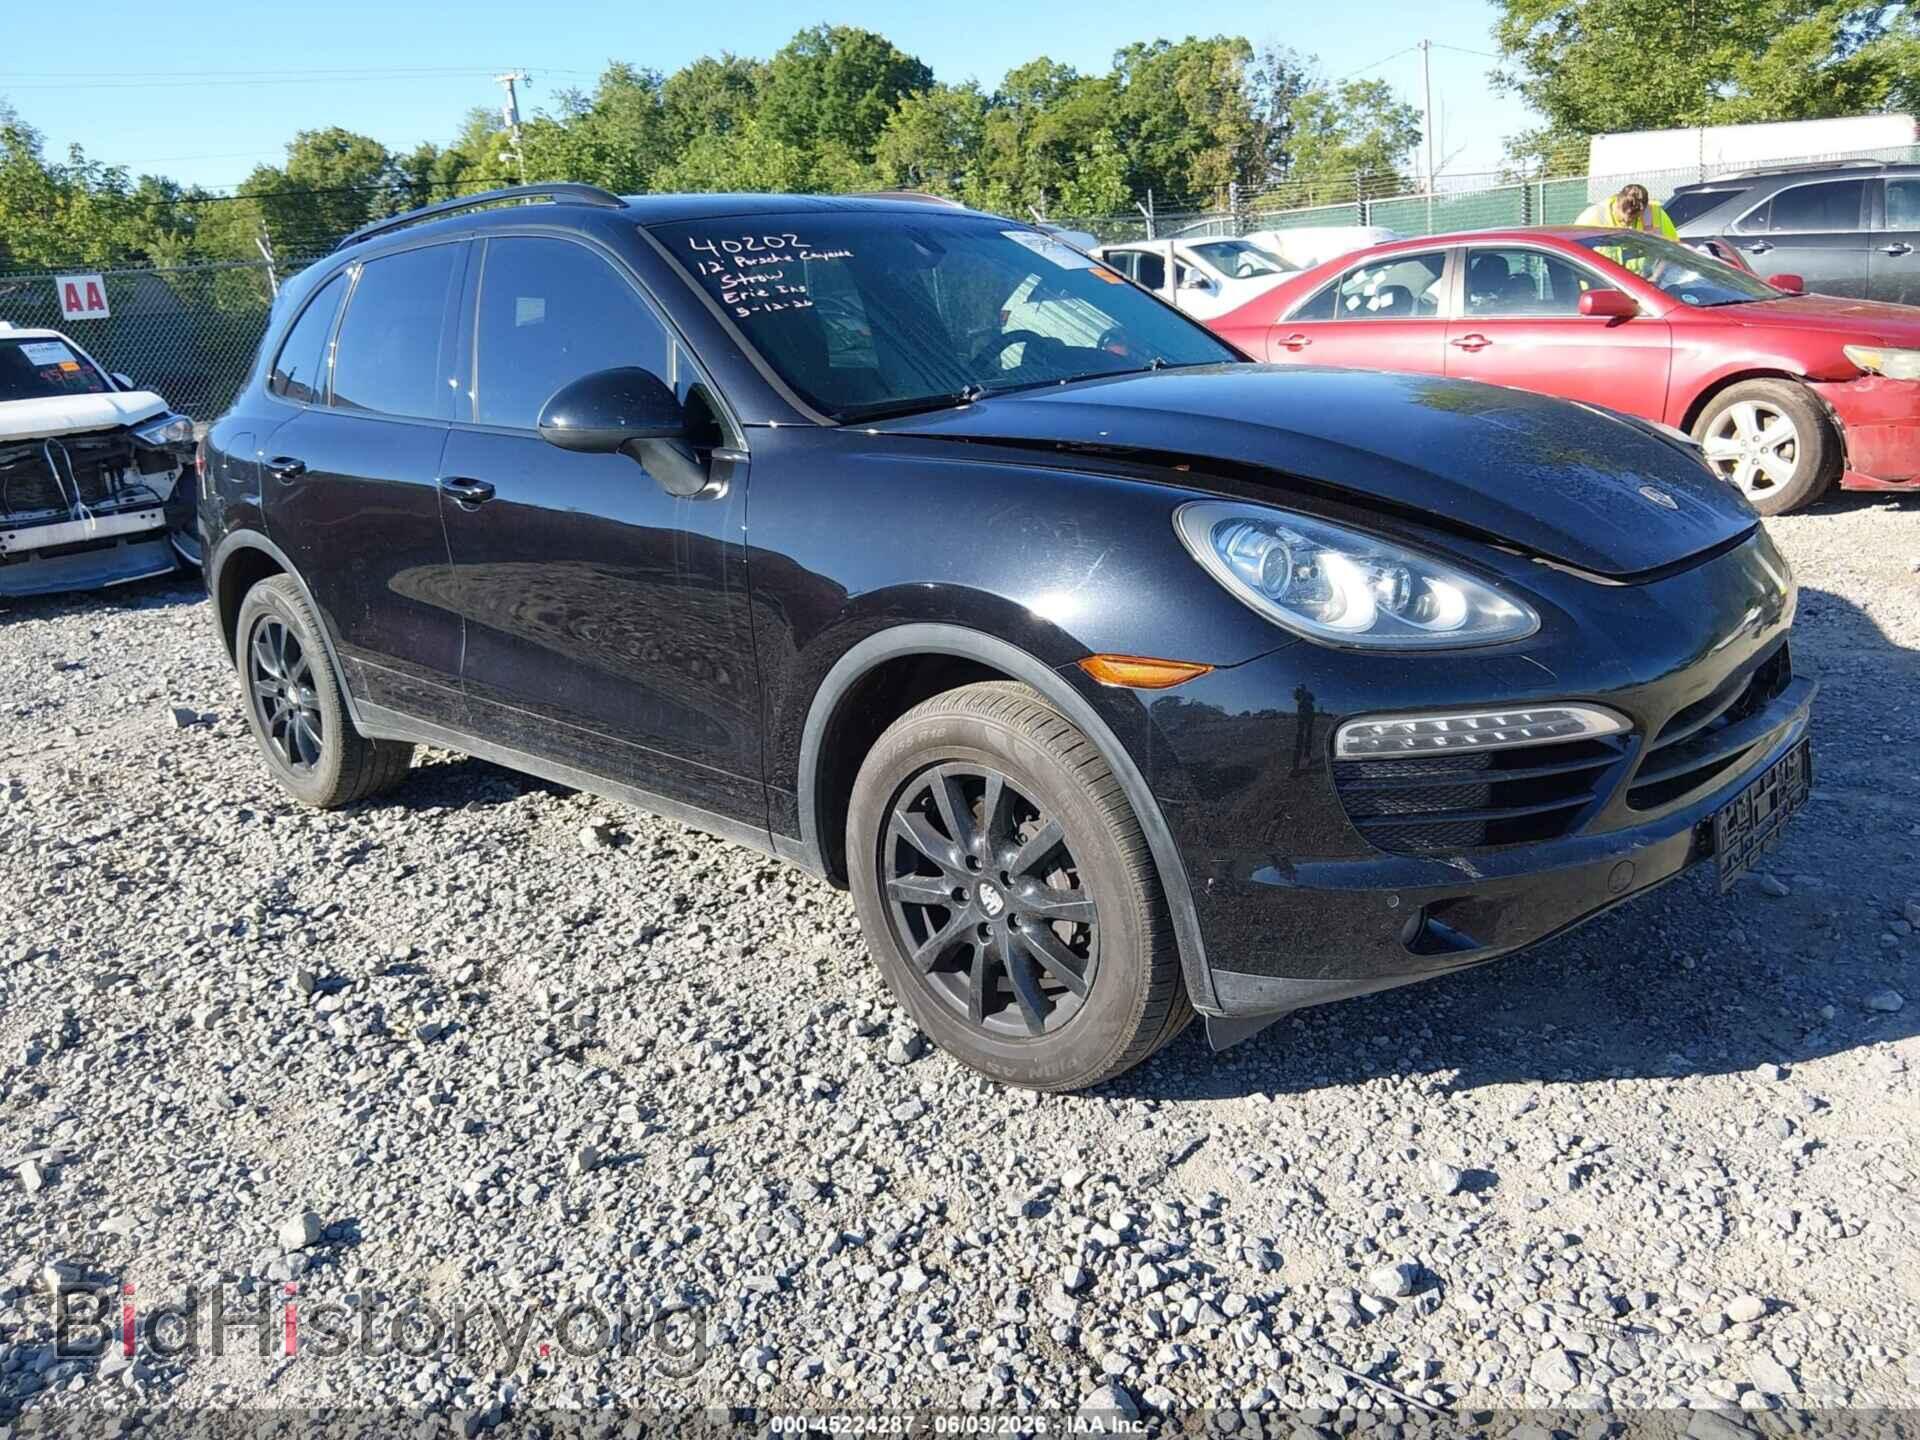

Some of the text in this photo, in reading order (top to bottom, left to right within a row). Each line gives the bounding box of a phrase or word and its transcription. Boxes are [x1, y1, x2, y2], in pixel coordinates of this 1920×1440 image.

[688, 233, 811, 257] 40202
[65, 282, 105, 312] AA
[723, 287, 769, 304] Erie
